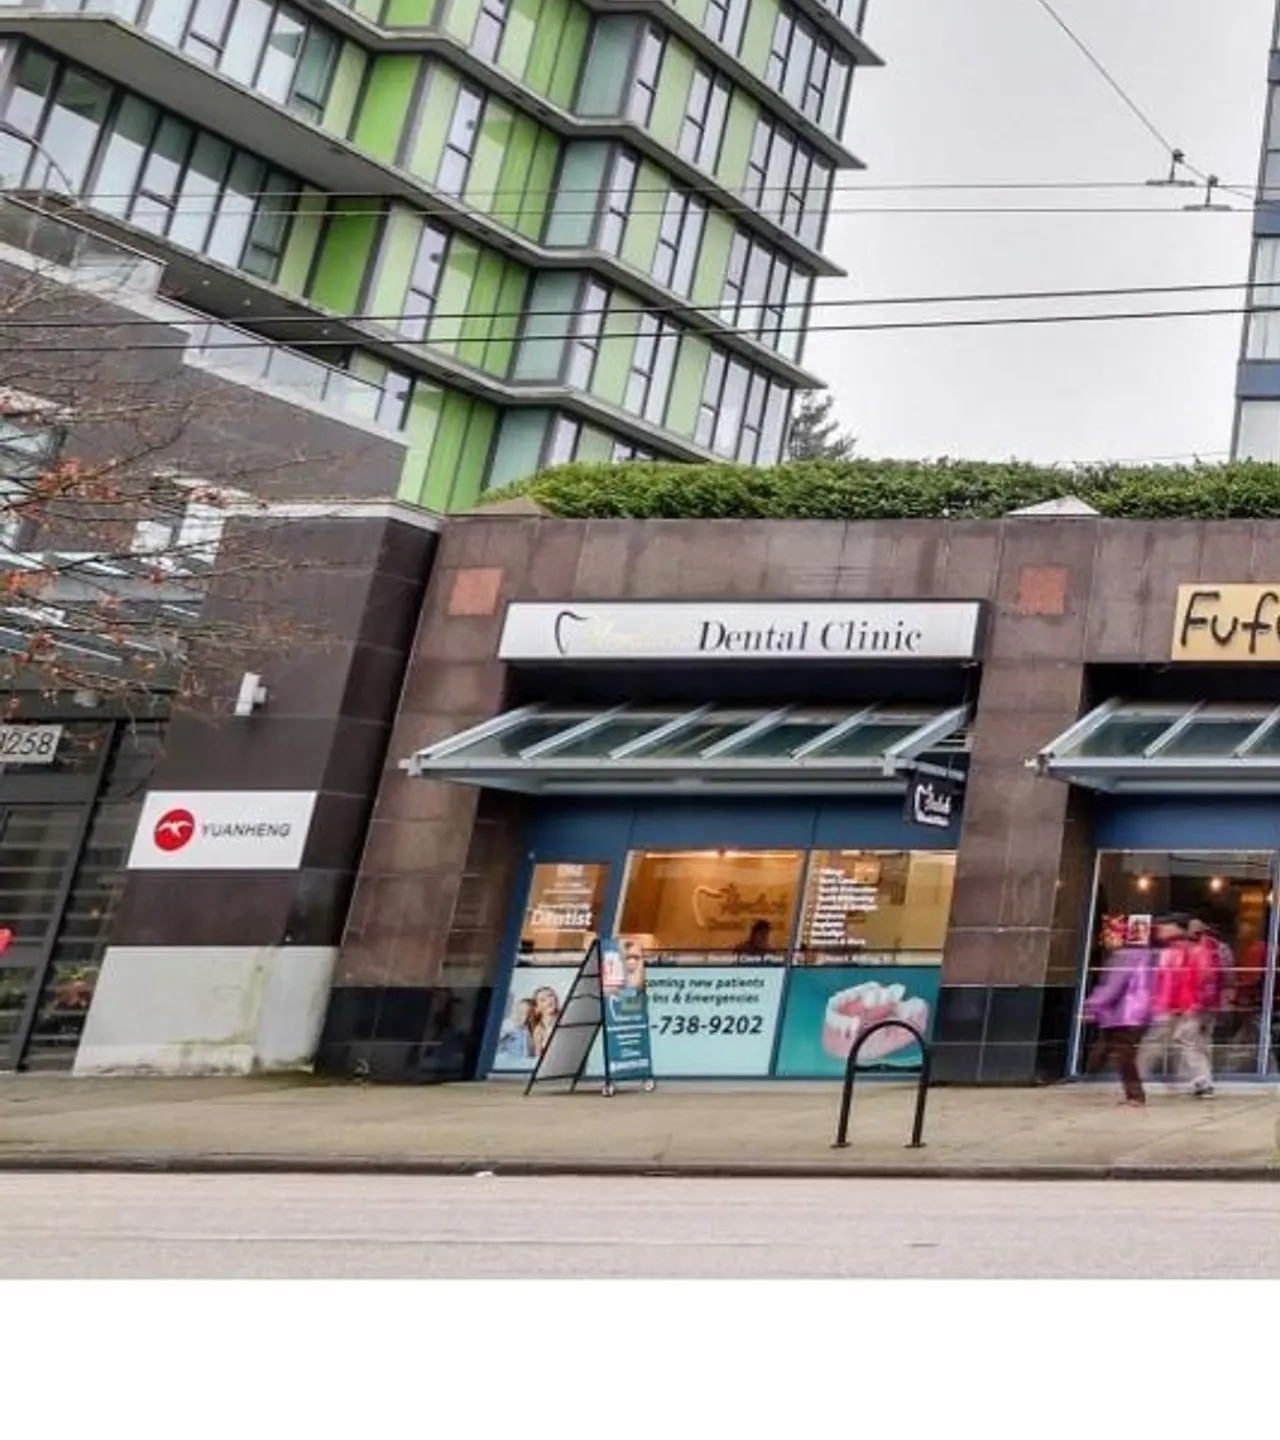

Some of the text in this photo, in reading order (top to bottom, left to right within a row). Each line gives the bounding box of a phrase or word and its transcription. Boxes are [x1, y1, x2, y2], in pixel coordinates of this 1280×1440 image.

[699, 619, 809, 652] Dental
[820, 619, 922, 653] Clinic
[202, 823, 292, 838] YUANHENG
